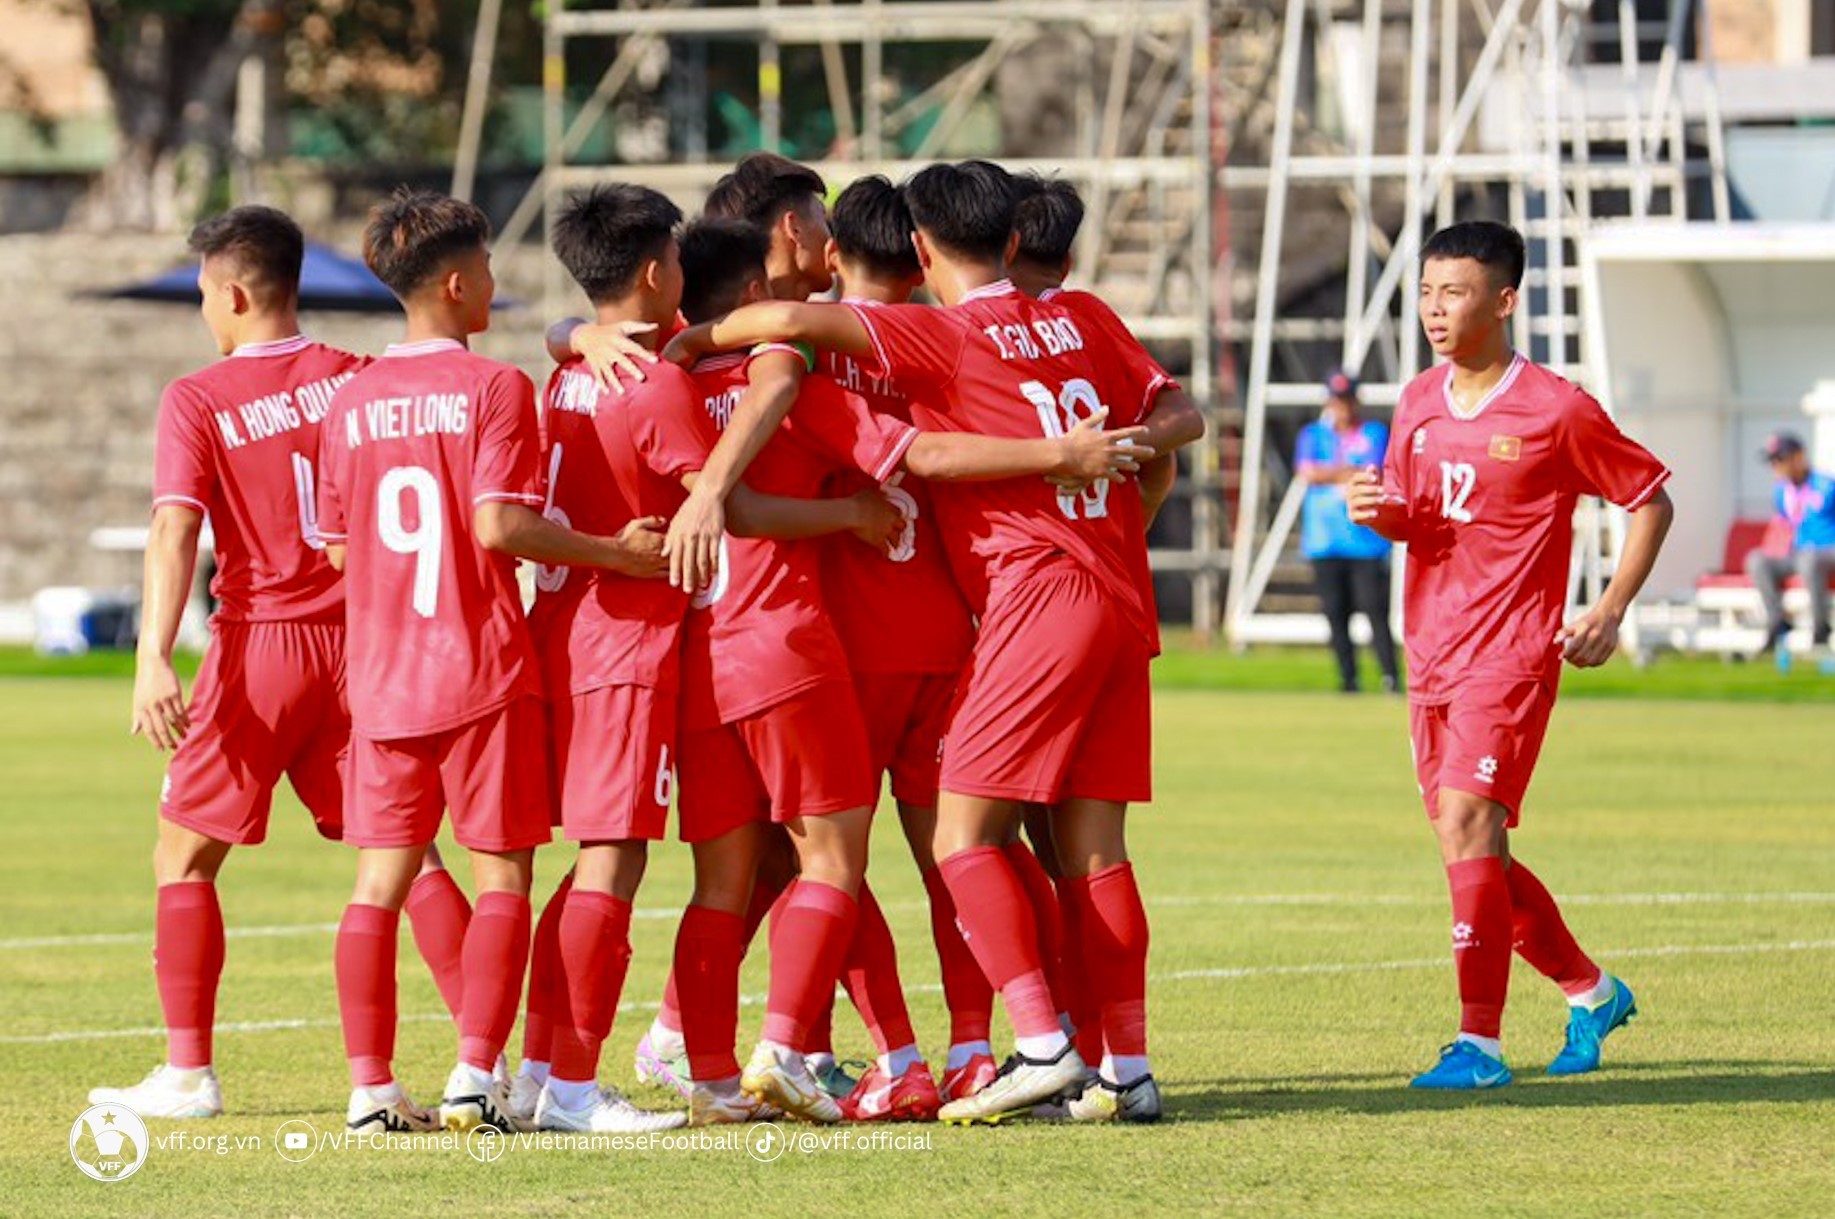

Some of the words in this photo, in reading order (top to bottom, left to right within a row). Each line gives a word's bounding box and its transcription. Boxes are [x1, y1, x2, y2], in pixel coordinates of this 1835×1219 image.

[1032, 316, 1084, 356] BAO
[239, 390, 301, 441] HONG
[295, 371, 354, 424] QUA
[365, 396, 412, 441] VIET
[413, 393, 469, 437] LONG
[1439, 460, 1476, 523] 12
[378, 466, 442, 617] 9
[654, 743, 672, 807] 6
